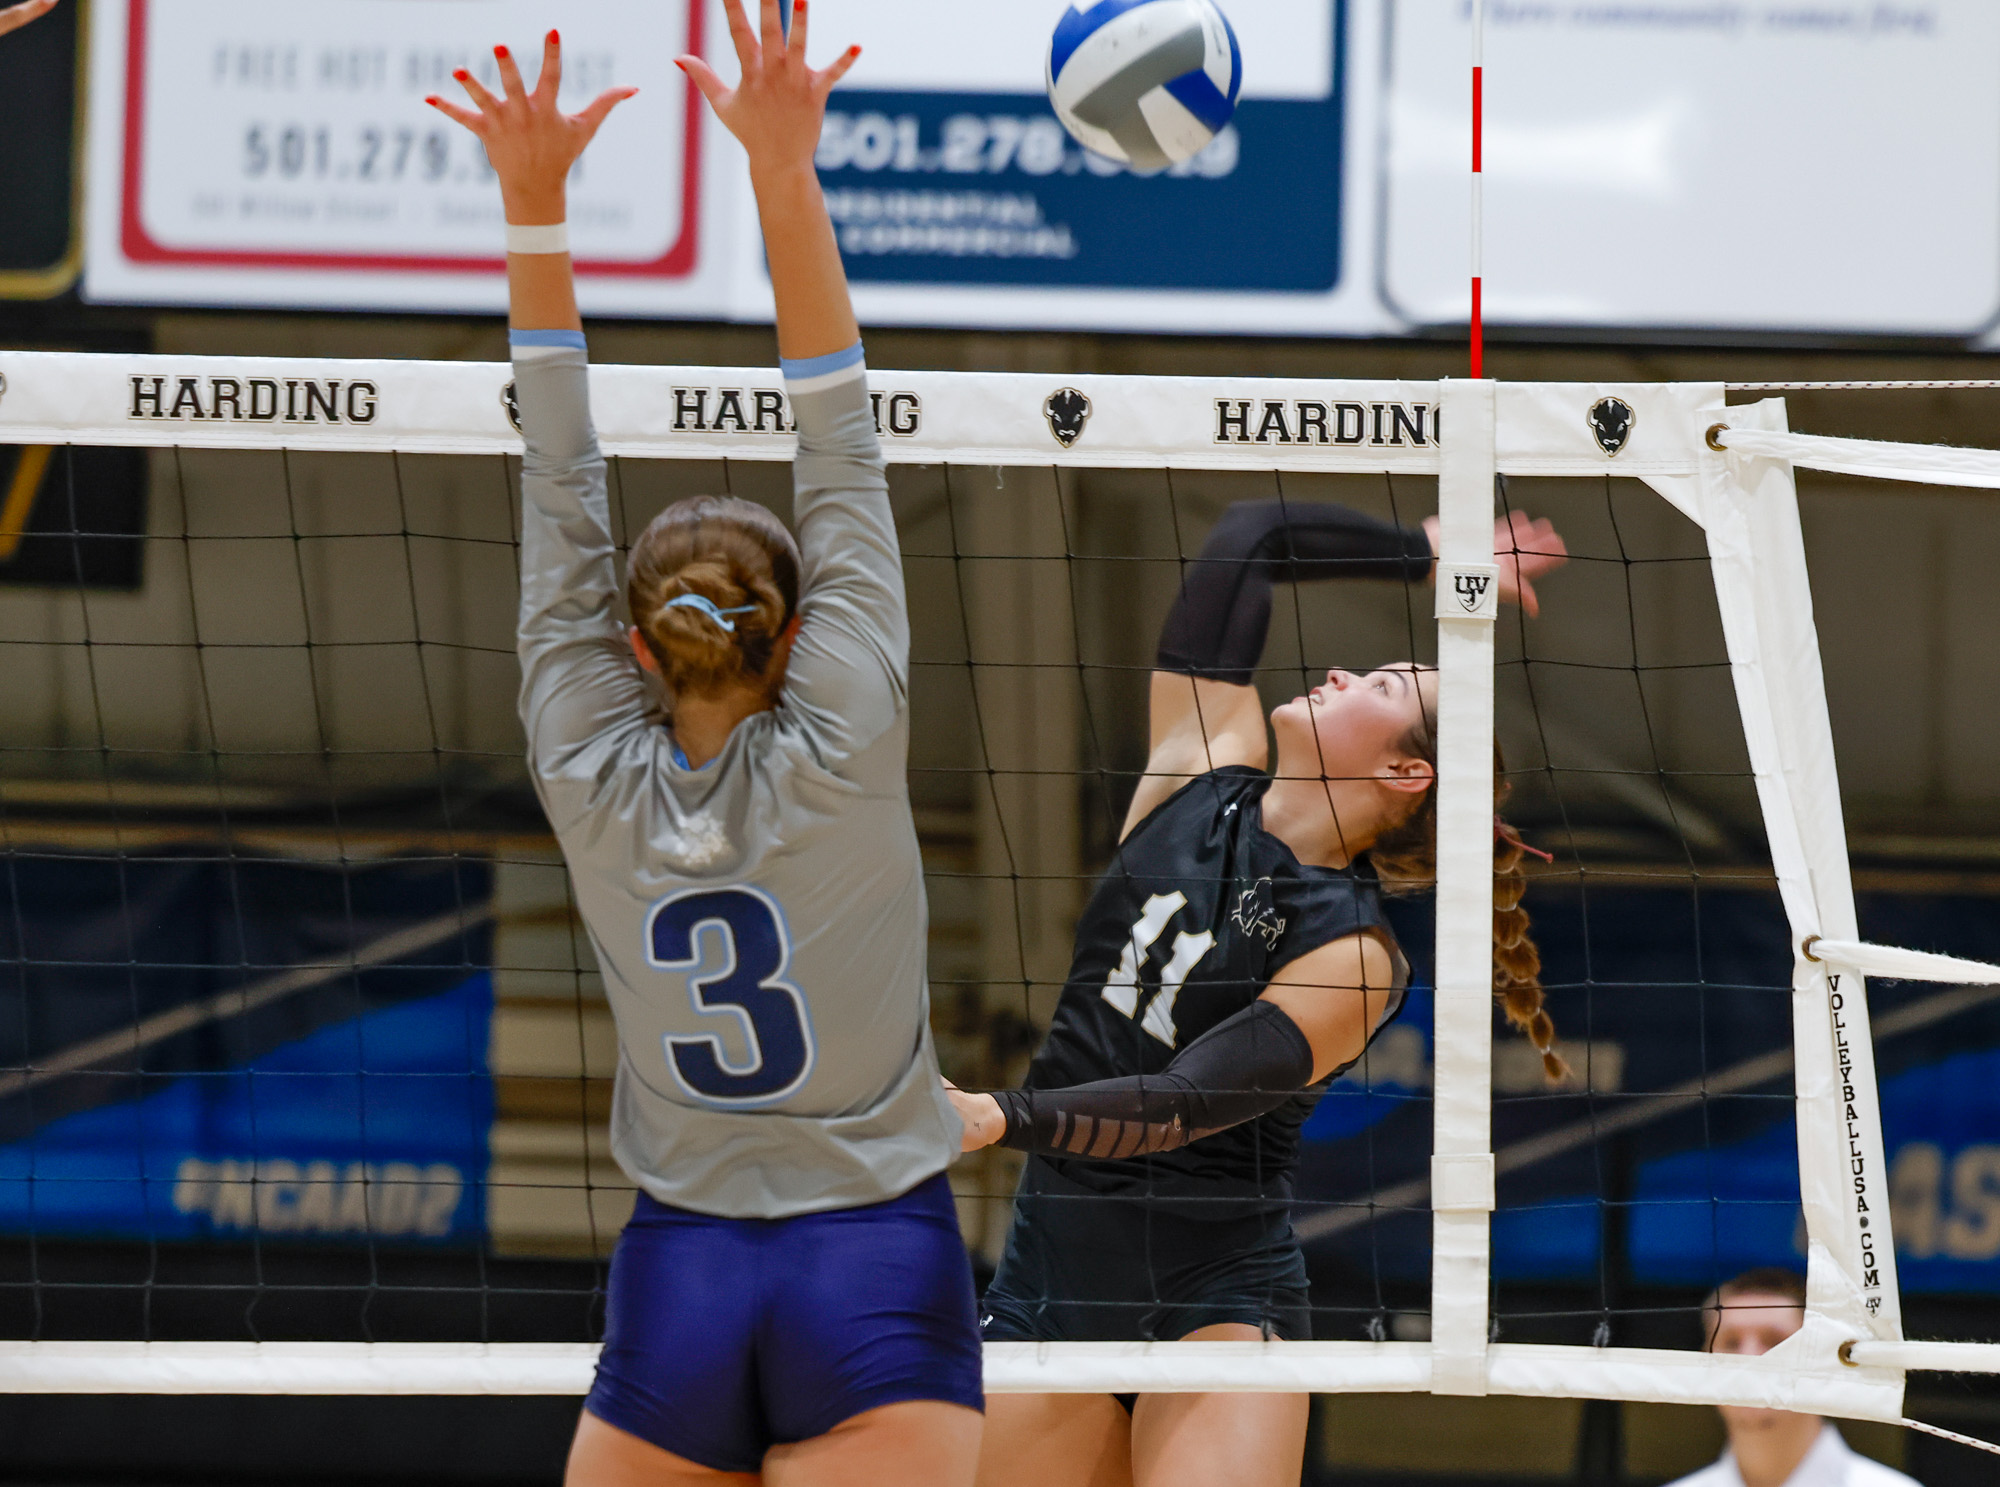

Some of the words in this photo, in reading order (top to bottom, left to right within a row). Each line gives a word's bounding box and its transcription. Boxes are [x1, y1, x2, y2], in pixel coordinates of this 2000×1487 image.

[127, 373, 381, 425] HARDING
[670, 386, 922, 437] HARG
[1213, 397, 1440, 448] HARDIN
[643, 883, 816, 1108] 3
[1101, 890, 1217, 1049] 11
